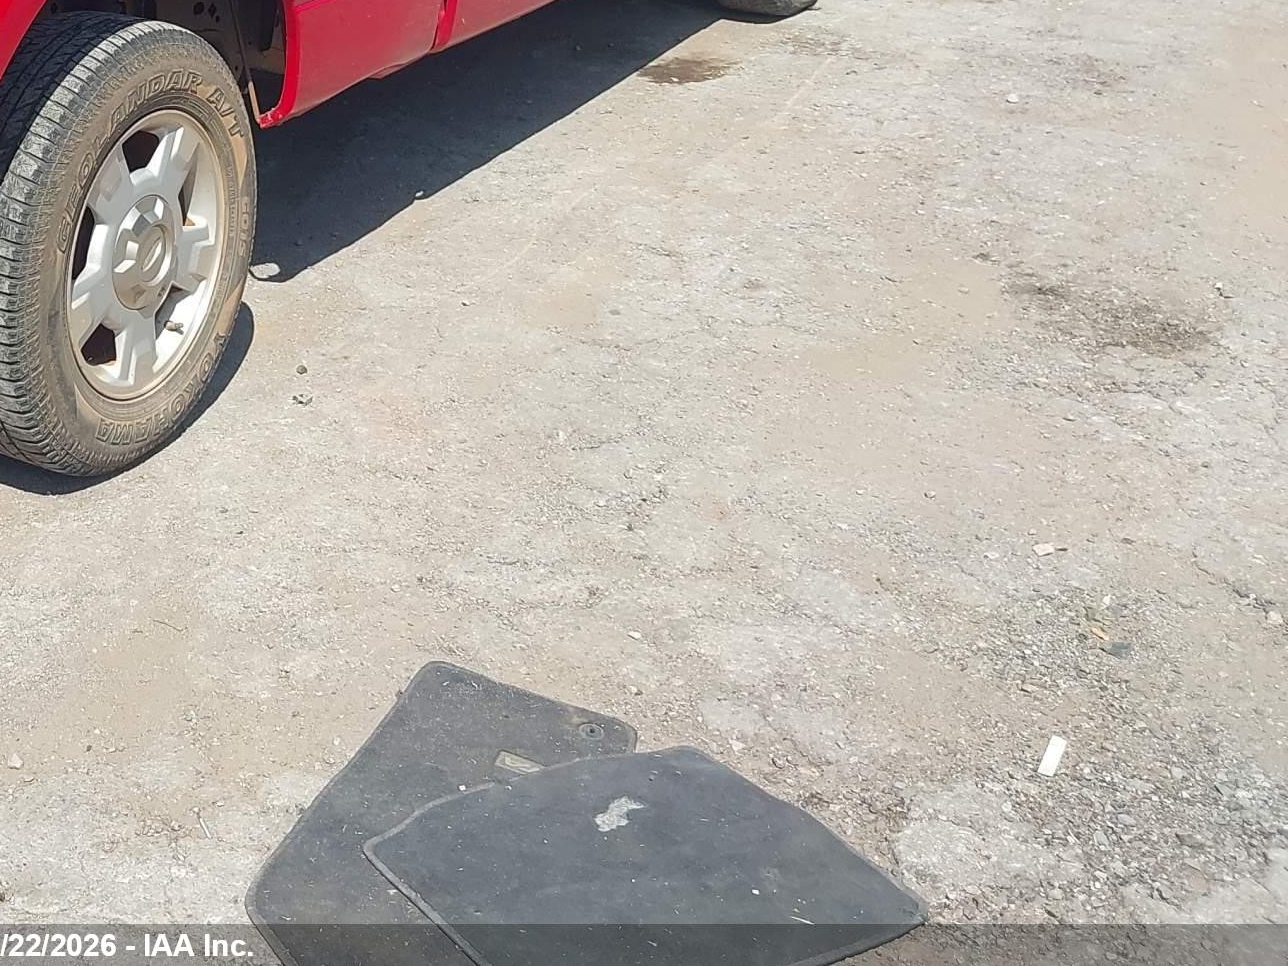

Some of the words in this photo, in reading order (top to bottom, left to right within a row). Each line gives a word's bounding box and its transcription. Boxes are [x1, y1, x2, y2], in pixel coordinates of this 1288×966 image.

[56, 68, 202, 254] GEOLANDAR
[206, 87, 245, 138] A/T
[95, 332, 229, 446] YOKOHAMA
